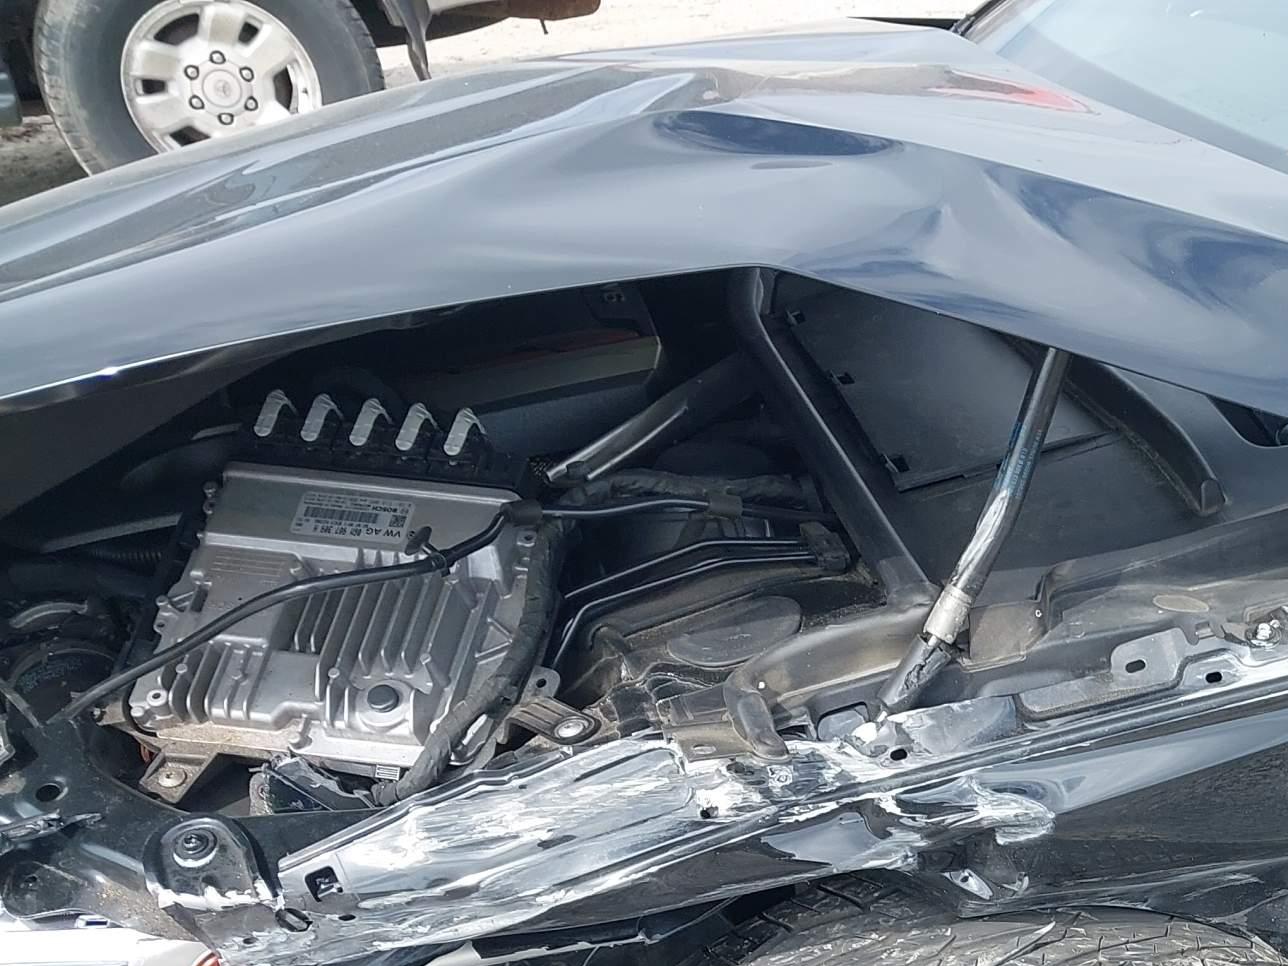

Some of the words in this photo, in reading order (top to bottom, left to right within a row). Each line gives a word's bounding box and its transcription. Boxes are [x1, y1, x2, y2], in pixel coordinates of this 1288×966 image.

[371, 505, 398, 513] BOSCH
[365, 526, 382, 536] AG
[383, 530, 401, 538] VW
